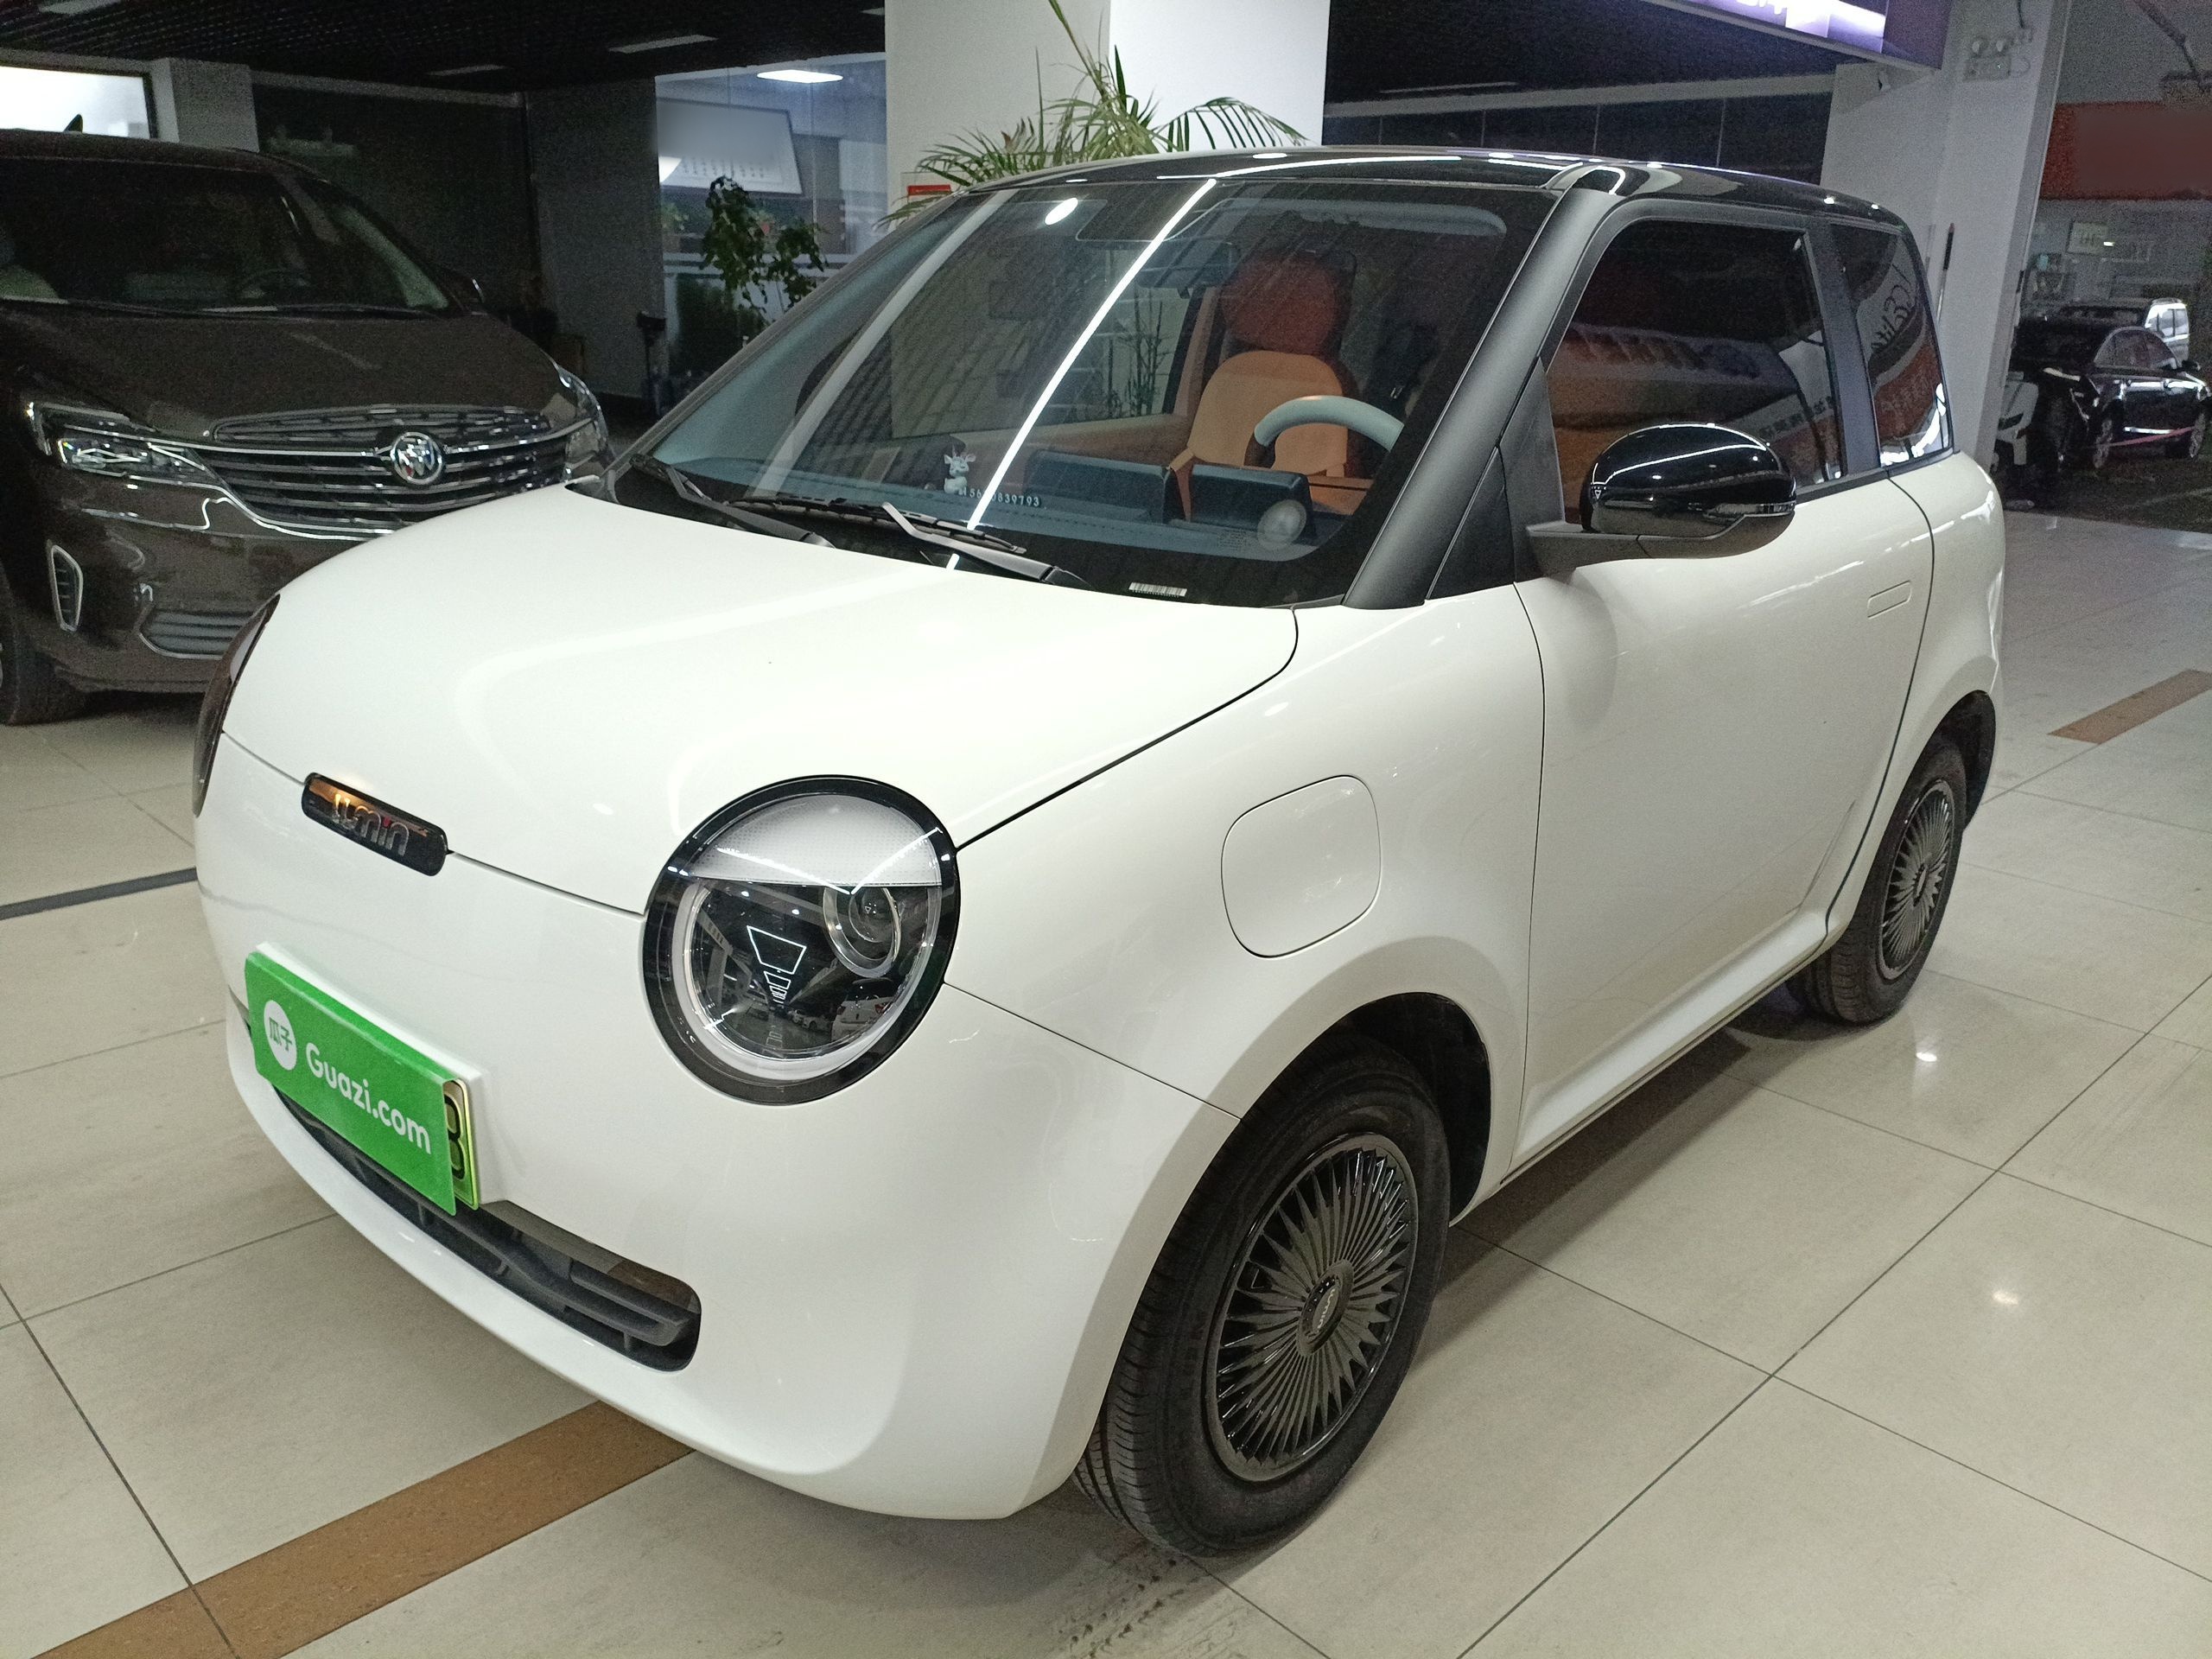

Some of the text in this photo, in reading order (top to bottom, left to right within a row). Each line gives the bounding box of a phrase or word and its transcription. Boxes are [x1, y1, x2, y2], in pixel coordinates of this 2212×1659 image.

[963, 486, 1039, 507] 1560839793
[268, 1016, 293, 1052] 瓜子
[306, 1042, 431, 1155] Guazi.com
